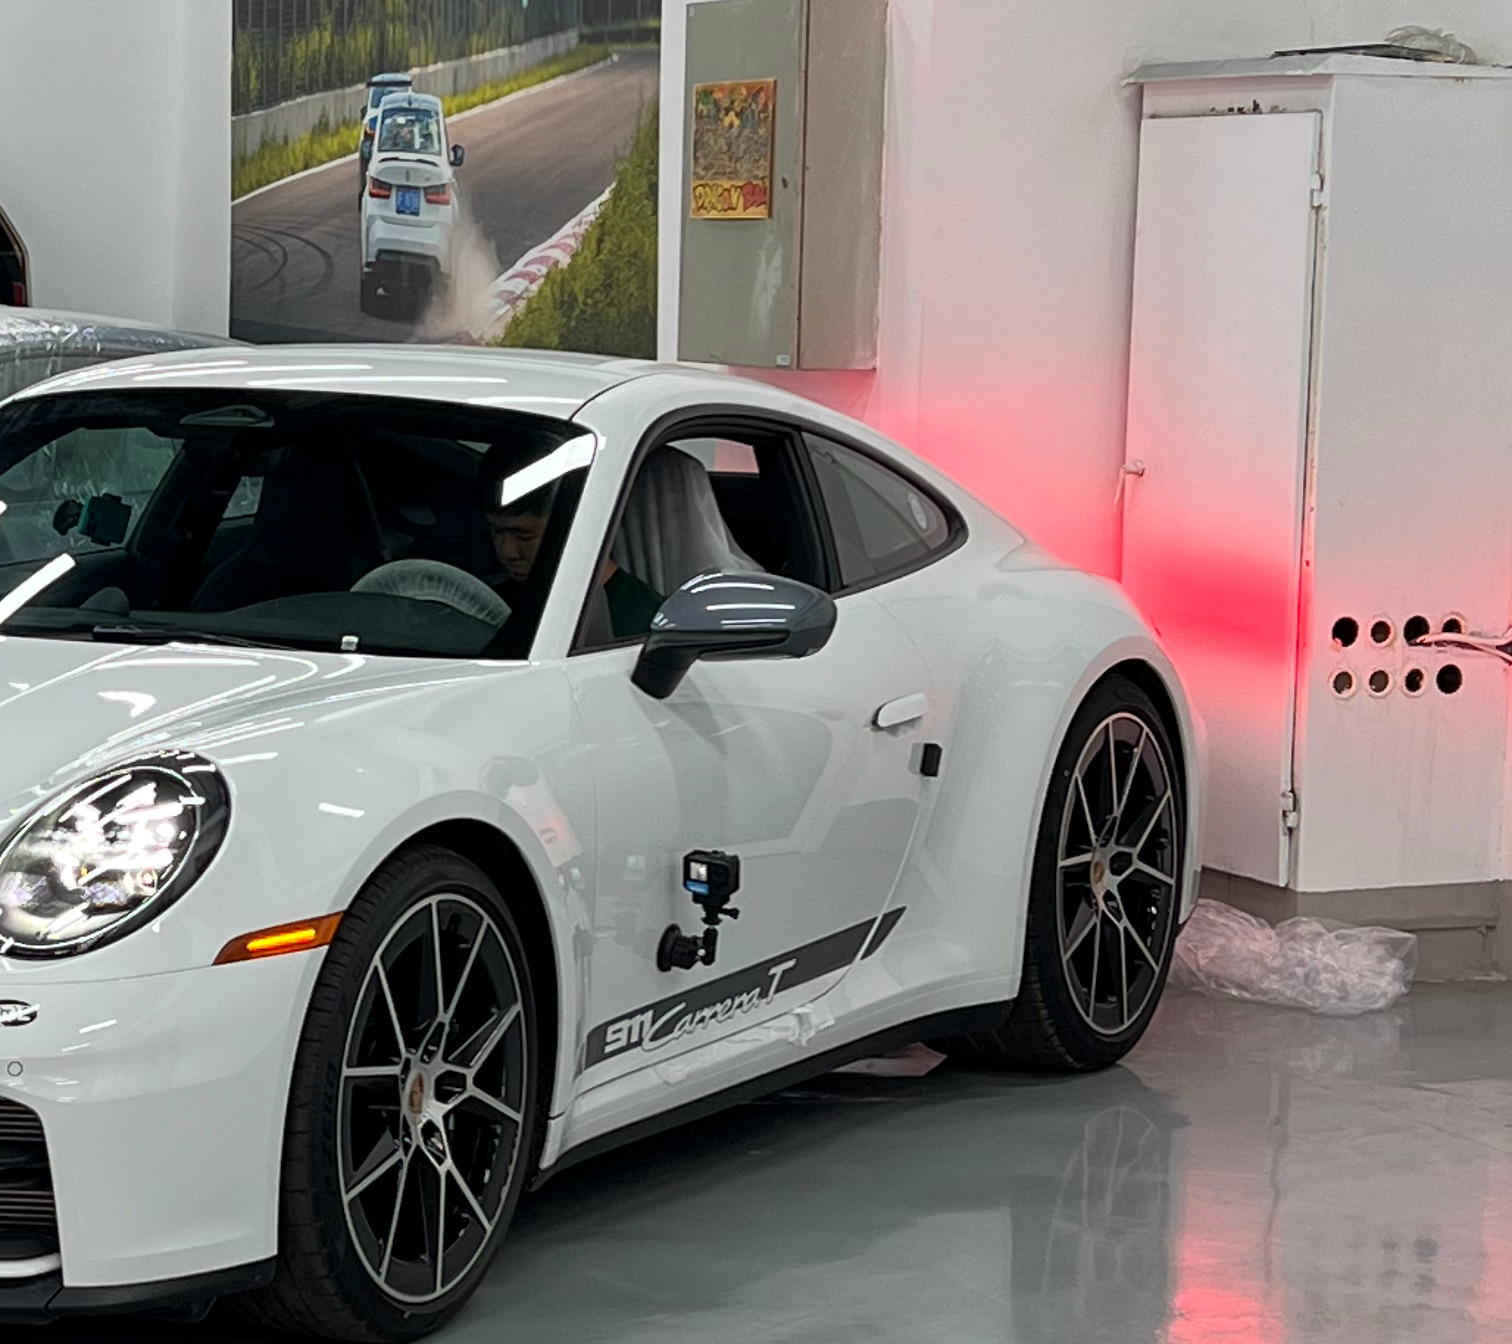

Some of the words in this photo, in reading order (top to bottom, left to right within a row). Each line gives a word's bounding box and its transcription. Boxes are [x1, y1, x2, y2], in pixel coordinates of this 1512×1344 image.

[604, 1010, 655, 1054] 911
[641, 1002, 761, 1052] Carrera
[767, 958, 797, 1005] T
